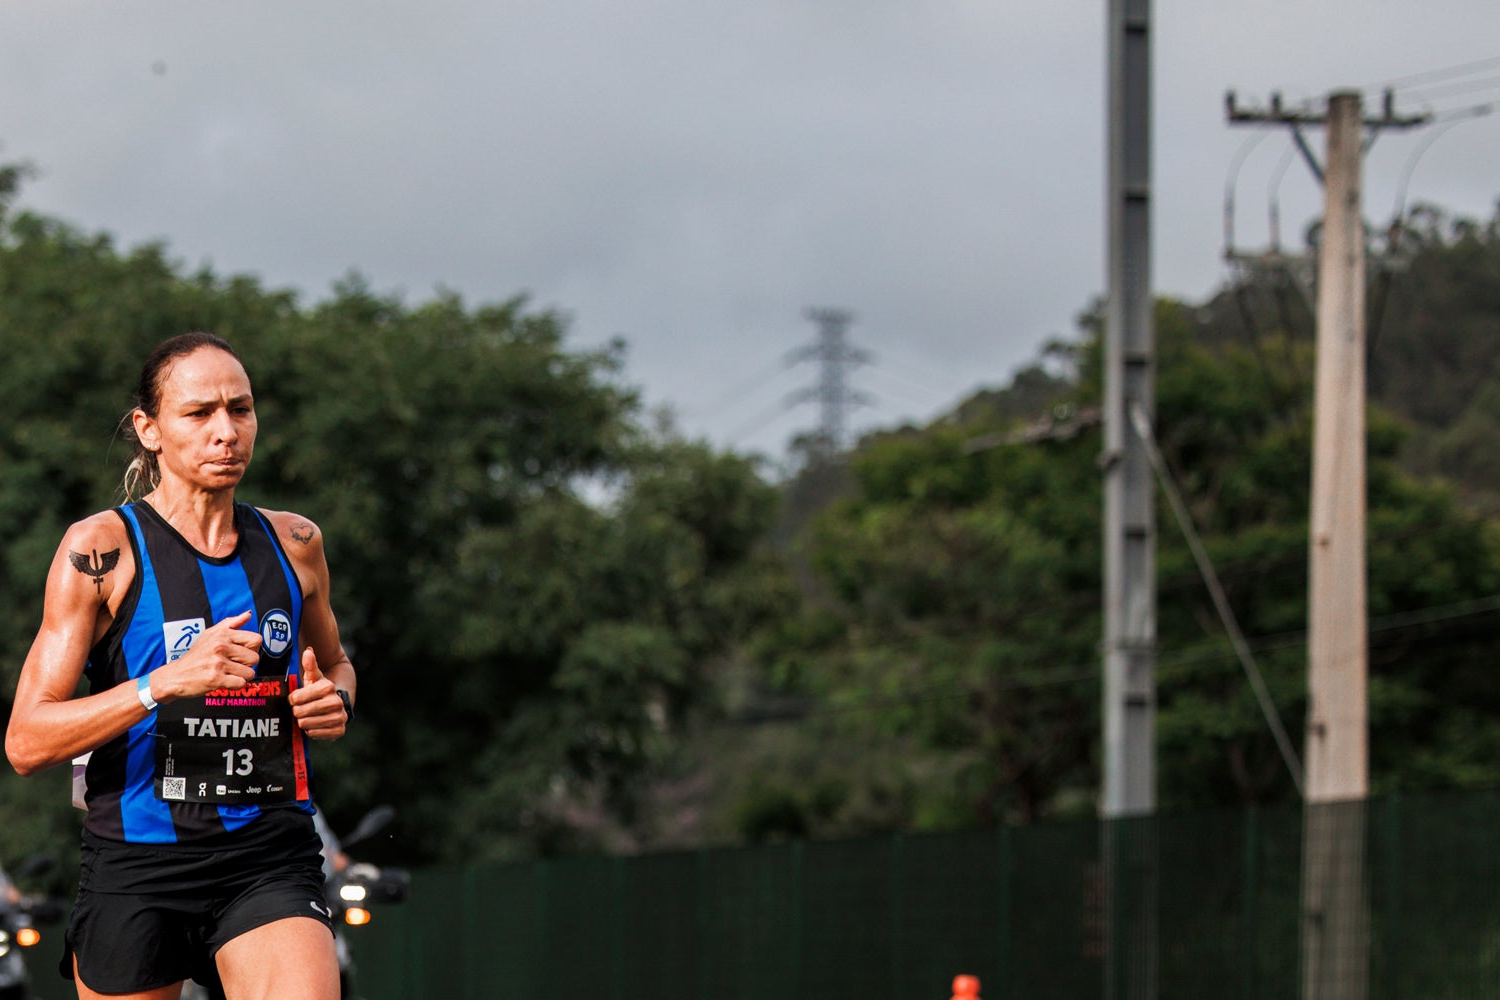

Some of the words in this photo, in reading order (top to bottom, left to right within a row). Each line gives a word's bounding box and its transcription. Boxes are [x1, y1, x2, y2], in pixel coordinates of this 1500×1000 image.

[206, 698, 226, 706] HALF
[227, 698, 266, 706] MARATHON
[184, 717, 280, 738] TATIANE
[222, 748, 254, 776] 13
[246, 786, 261, 794] Jeep
